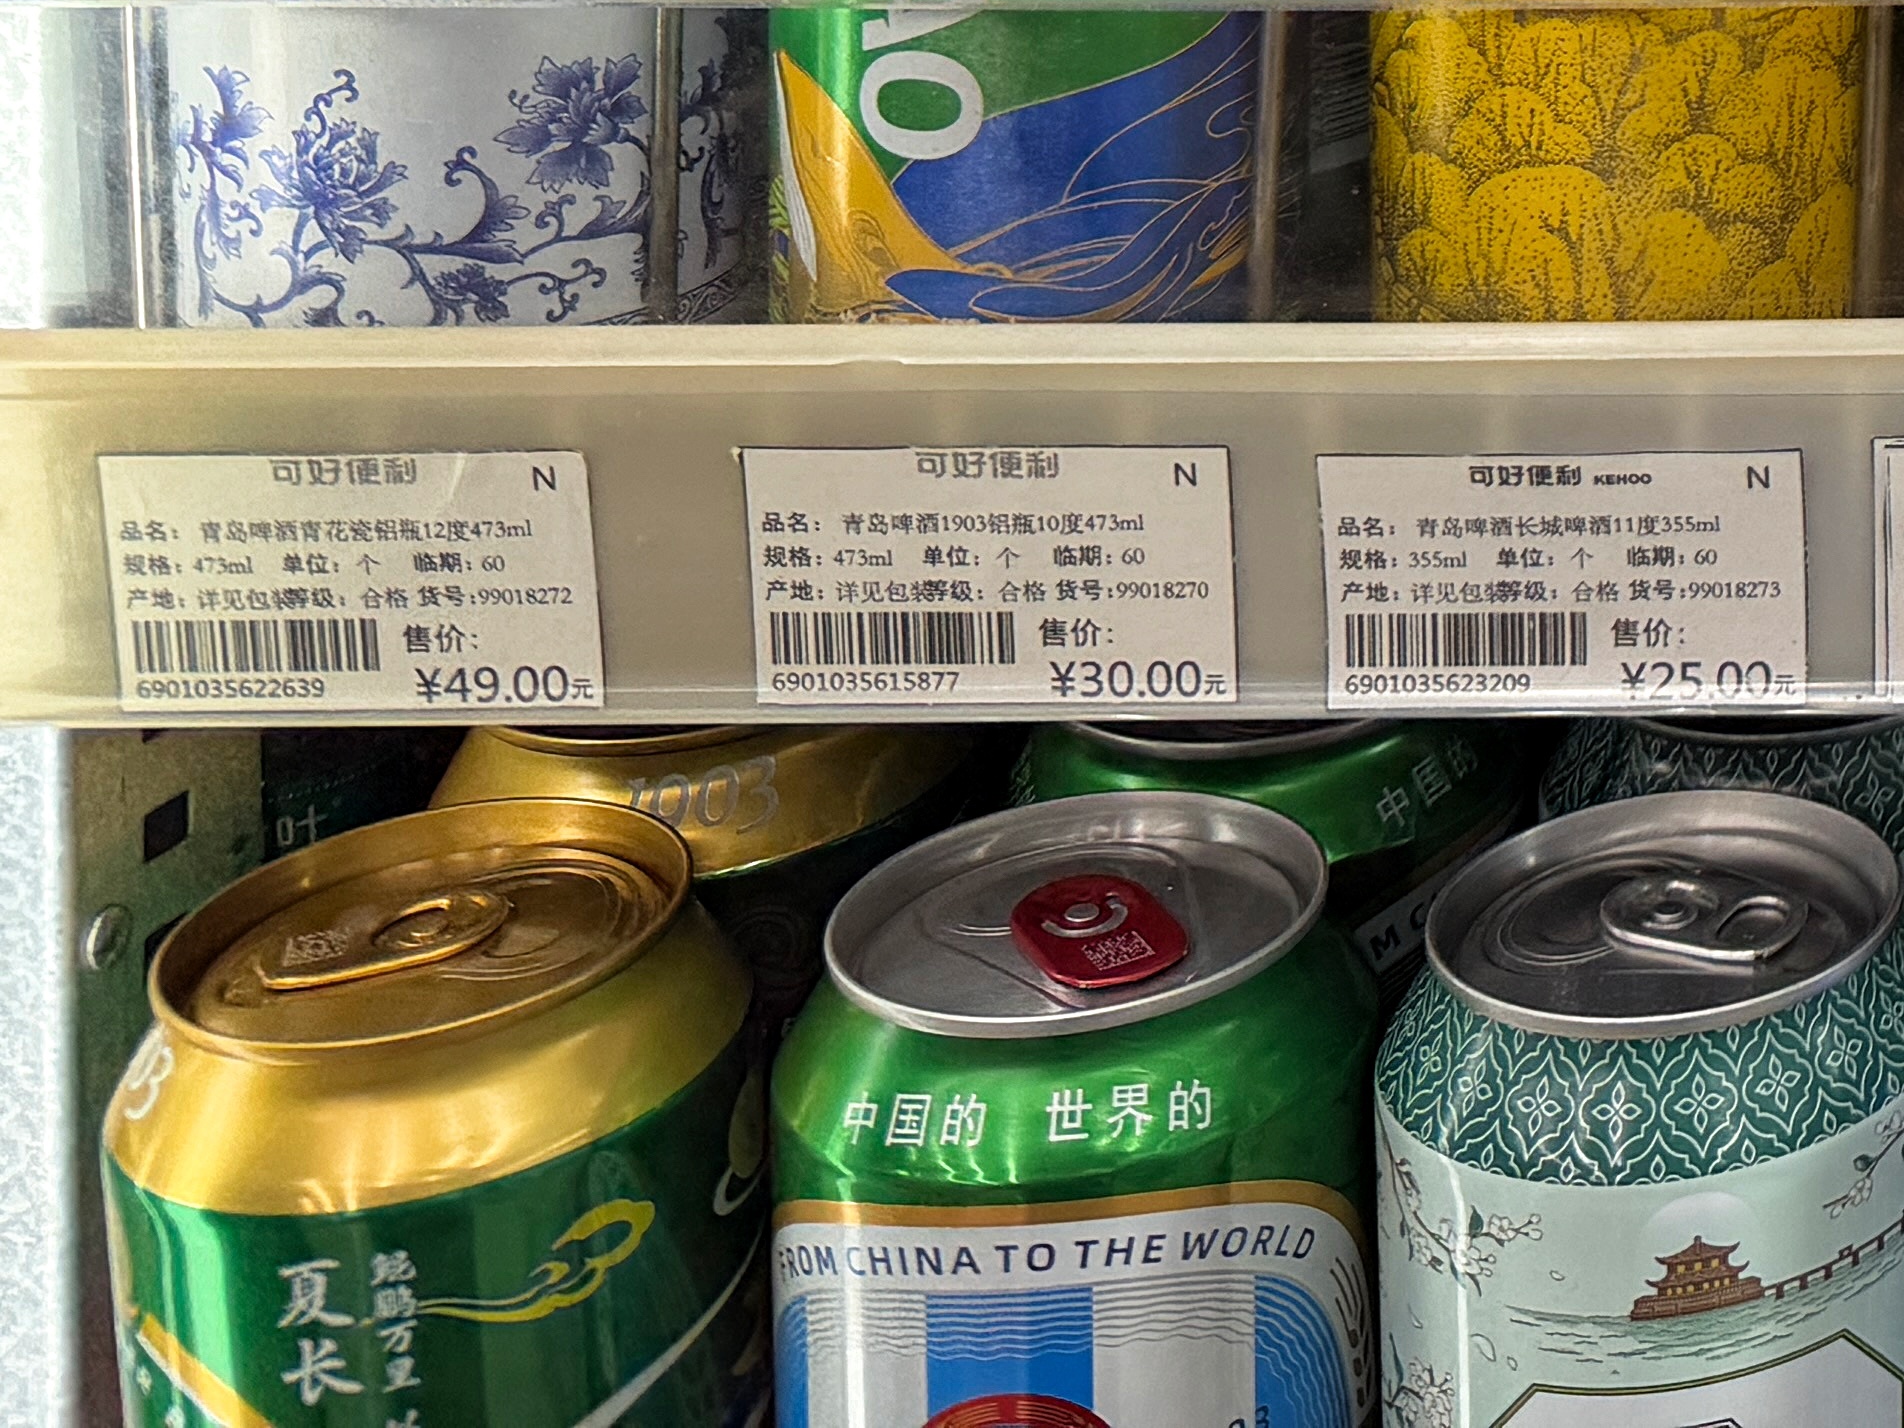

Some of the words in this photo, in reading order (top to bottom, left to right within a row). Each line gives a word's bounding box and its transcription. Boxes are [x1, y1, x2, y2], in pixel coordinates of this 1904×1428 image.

[915, 450, 1060, 480] 可好便利
[136, 677, 326, 700] 6901035622639
[415, 665, 594, 704] ¥49.00元
[772, 669, 961, 693] 6901035615877
[1049, 660, 1227, 698] ¥30.00元
[1344, 672, 1532, 695] 6901035623209
[843, 1090, 988, 1147] 中国的
[1045, 1078, 1213, 1143] 世界的
[847, 1244, 982, 1279] CHINA
[993, 1242, 1056, 1274] TO
[1073, 1233, 1167, 1270] THE
[1179, 1223, 1317, 1263] WORLD
[276, 1257, 366, 1407] 夏长
